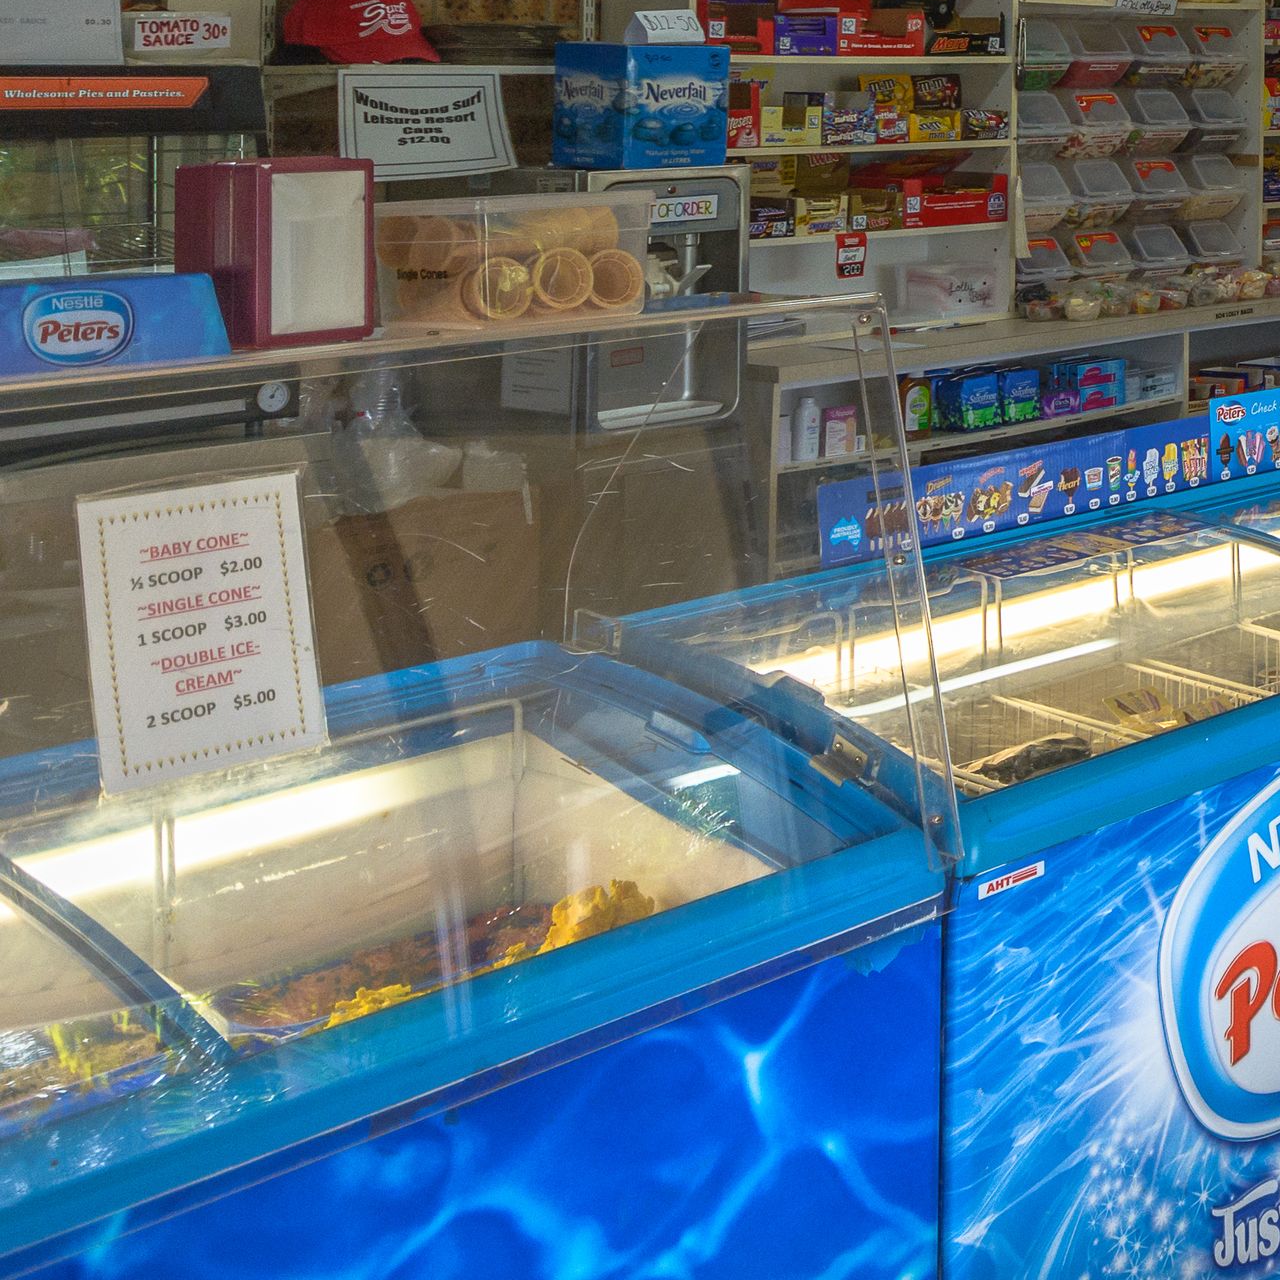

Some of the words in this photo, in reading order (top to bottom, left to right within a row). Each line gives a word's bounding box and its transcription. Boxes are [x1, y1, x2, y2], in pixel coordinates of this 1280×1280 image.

[138, 19, 199, 34] TOMATO
[142, 33, 194, 47] SAUCE
[4, 89, 76, 99] Wholesome
[78, 89, 104, 98] Pies
[106, 89, 129, 98] and
[132, 88, 185, 98] Pastries.
[563, 80, 604, 100] Neverfail
[645, 82, 707, 102] Neverfail
[355, 90, 449, 116] Wollongong
[452, 90, 482, 110] Surf
[363, 112, 421, 125] Leisure
[425, 111, 476, 124] Resort
[402, 126, 443, 136] Caps
[397, 136, 451, 146] $12.00
[658, 202, 675, 218] OF
[675, 200, 712, 217] ORDER
[38, 320, 120, 344] Peters
[1217, 405, 1246, 422] Peters
[1251, 402, 1276, 415] Check
[1058, 477, 1080, 492] Heart
[831, 529, 860, 539] AUSTRALIAN
[833, 524, 857, 533] PROUDLY
[148, 567, 204, 588] SCOOP
[220, 556, 263, 576] $2.00
[138, 633, 147, 647] 1
[152, 622, 207, 644] SCOOP
[224, 610, 267, 631] $3.00
[146, 714, 156, 729] 2
[160, 702, 216, 726] SCOOP
[233, 688, 276, 710] $5.00
[986, 876, 1012, 895] AHT
